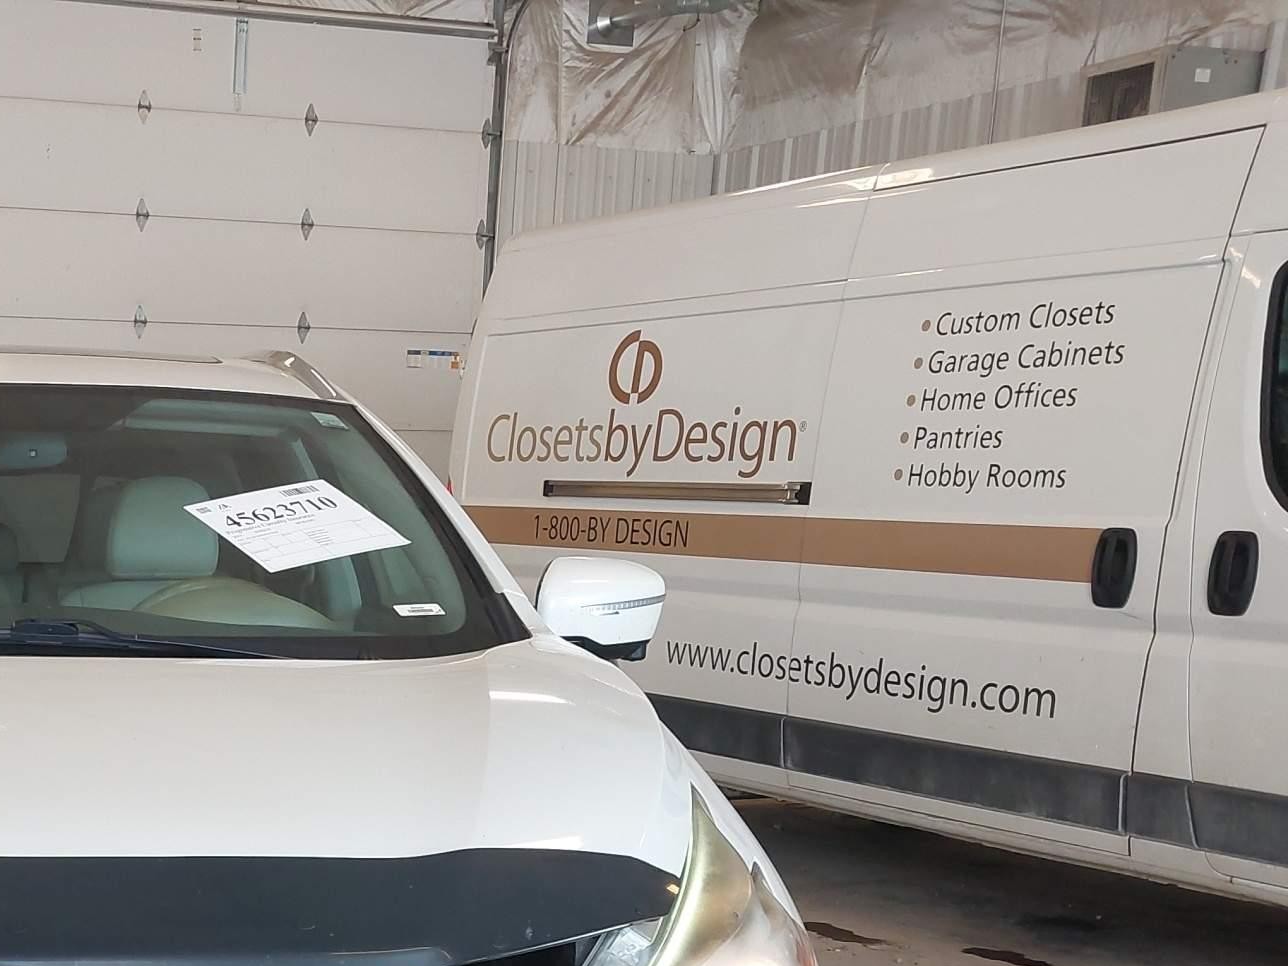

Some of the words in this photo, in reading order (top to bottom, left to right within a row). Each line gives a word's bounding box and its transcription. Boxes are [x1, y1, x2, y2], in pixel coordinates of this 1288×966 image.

[936, 311, 1021, 336] Custom
[1029, 300, 1116, 329] Closets
[928, 350, 1010, 378] Garage
[1017, 340, 1126, 369] Cabinets
[920, 387, 986, 412] Home
[994, 381, 1079, 409] Offices
[487, 406, 798, 479] ClosetsbyDesign
[913, 424, 1004, 450] Pantries
[907, 462, 980, 495] Hobby
[986, 463, 1067, 489] Rooms
[226, 496, 338, 527] 45623710
[533, 514, 611, 543] 1-800-BY
[614, 516, 689, 548] DESIGN
[666, 640, 1057, 719] www.closetsbydesign.com
